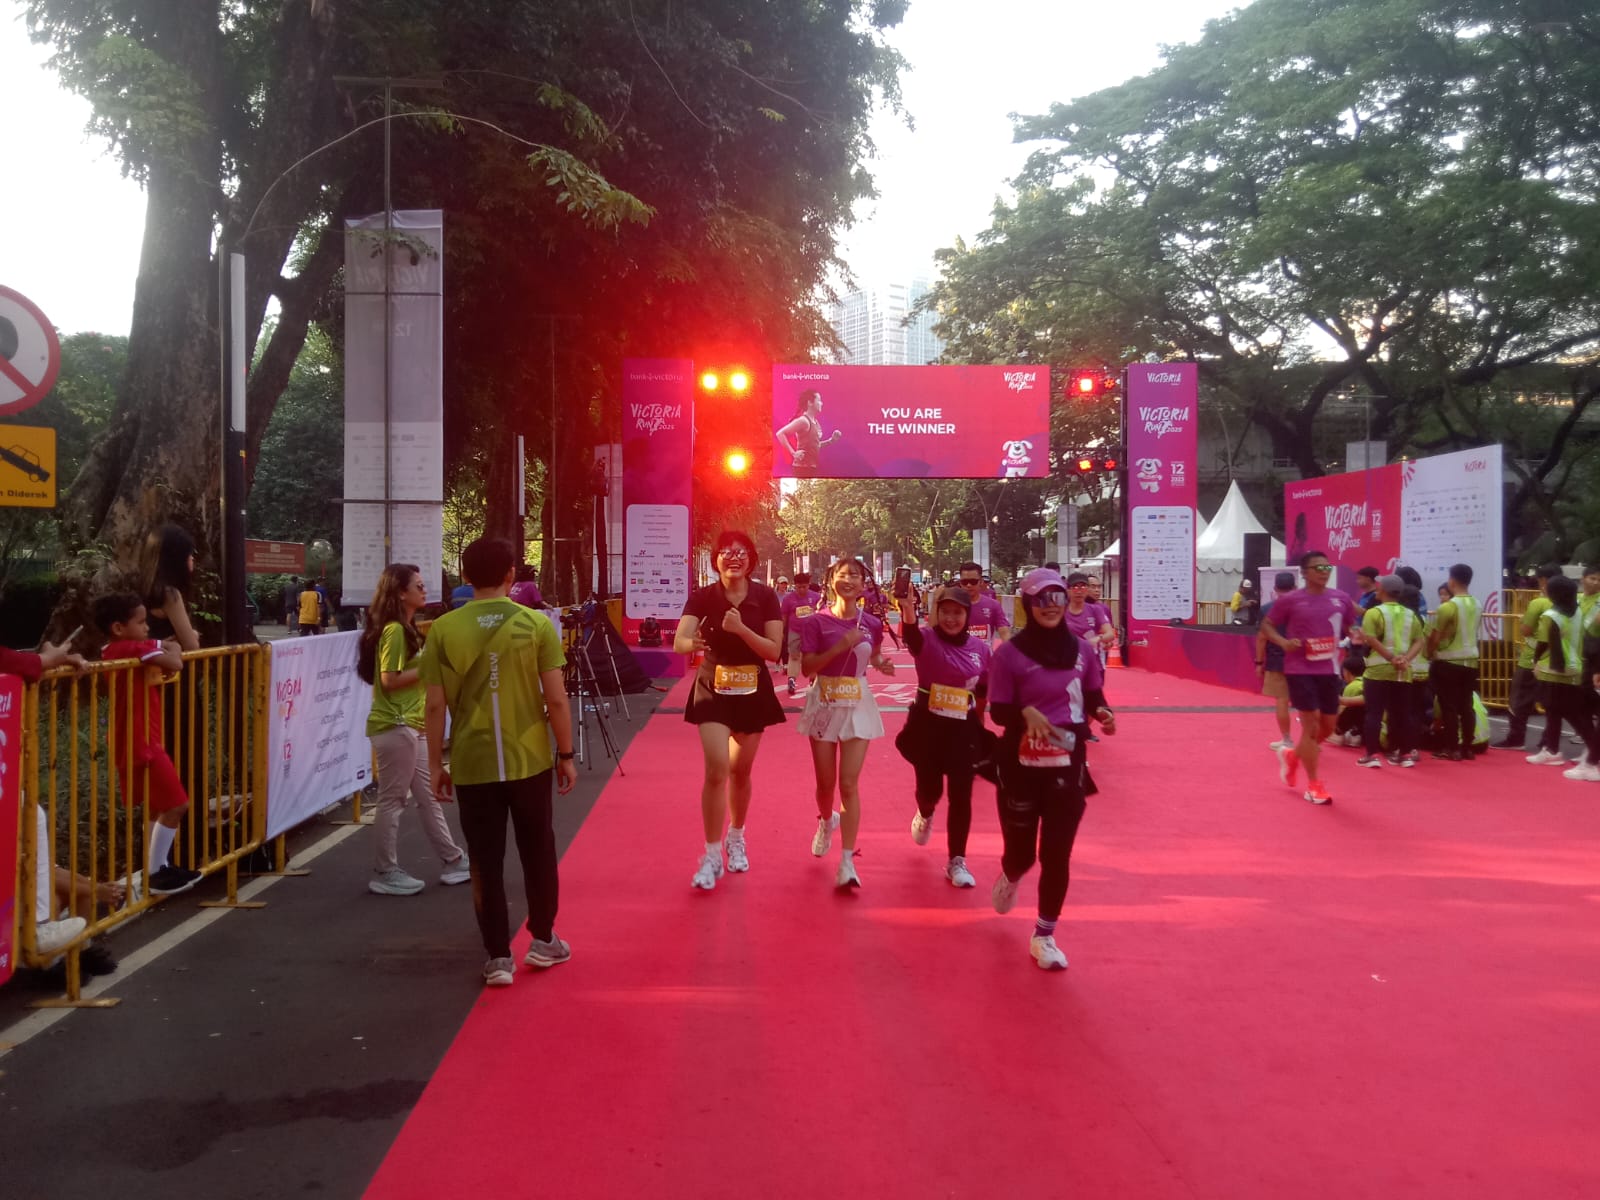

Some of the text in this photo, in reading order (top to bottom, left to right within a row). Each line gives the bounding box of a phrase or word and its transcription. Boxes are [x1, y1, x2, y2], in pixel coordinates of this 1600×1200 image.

[803, 372, 830, 380] victoria
[1003, 371, 1036, 383] VICTORIA
[1147, 372, 1182, 383] VICTORIA
[630, 403, 682, 419] VICTORIA
[881, 407, 942, 419] YOU ARE
[1139, 406, 1189, 421] VICTORIA
[867, 423, 956, 435] THE WINNER
[1170, 463, 1185, 475] 12
[1324, 501, 1367, 529] VICTORIA
[1371, 513, 1382, 526] 12
[489, 652, 500, 689] CREW
[721, 671, 755, 682] 51295
[283, 743, 292, 760] 12
